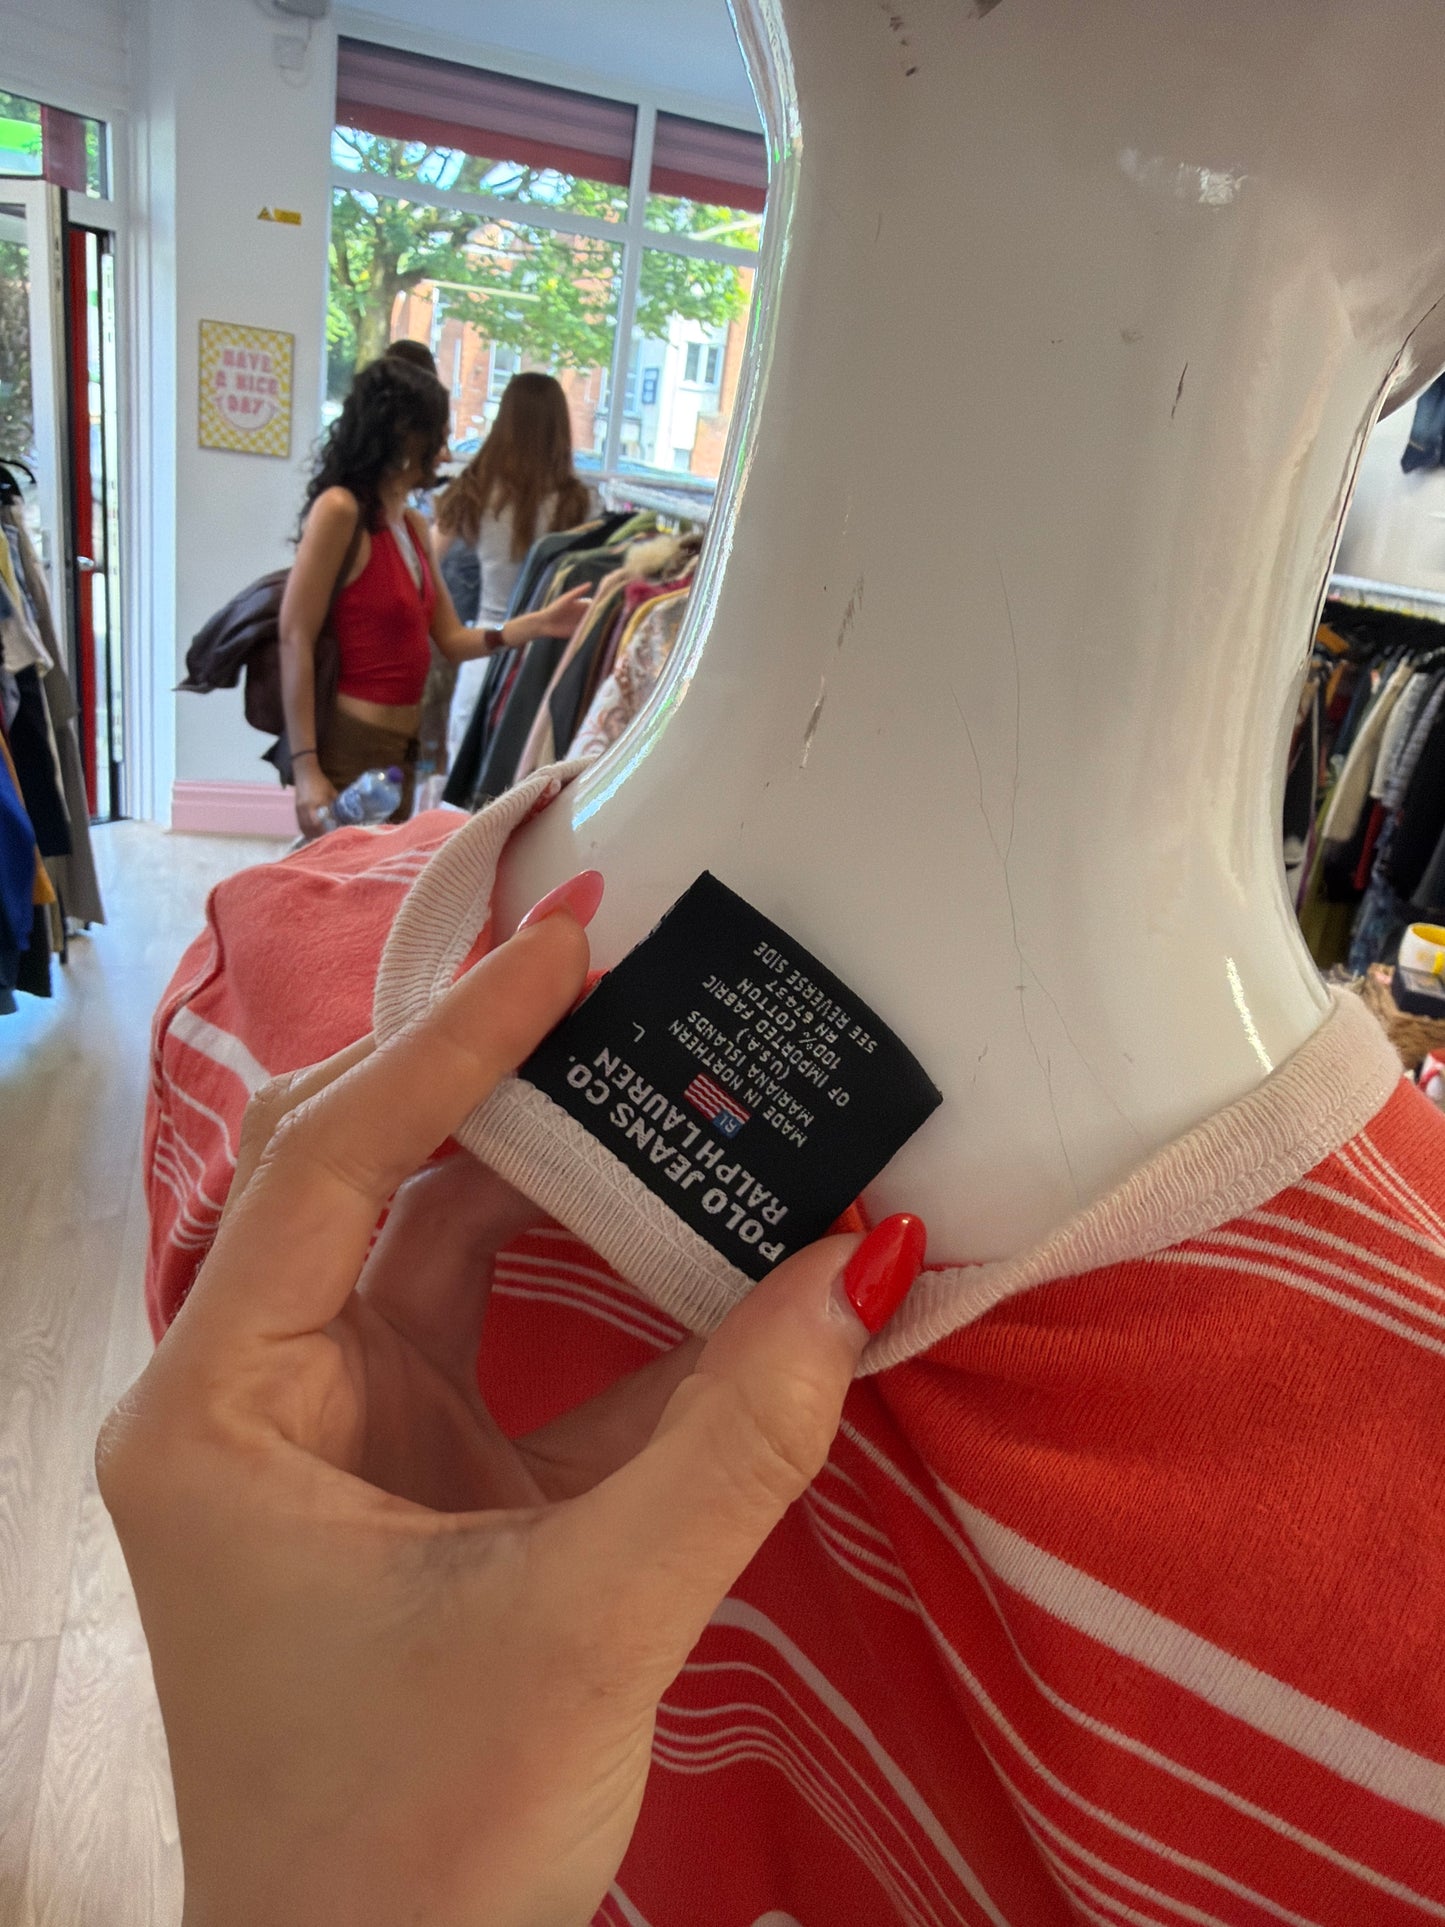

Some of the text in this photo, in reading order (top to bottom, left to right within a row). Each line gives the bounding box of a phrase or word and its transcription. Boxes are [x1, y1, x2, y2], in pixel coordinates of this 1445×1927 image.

[224, 349, 271, 373] HAVE
[228, 395, 264, 415] DAY
[632, 1021, 646, 1043] L
[702, 975, 850, 1107] OF IMPORTED FABRIC
[736, 978, 841, 1070] 100% COTTON
[753, 941, 878, 1054] SEE REVERSE SIDE
[814, 1022, 839, 1044] RN
[668, 1019, 808, 1148] MADE IN NORTHERN
[687, 1010, 815, 1128] MARIANA ISLANDS
[566, 1055, 785, 1263] POLO JEANS CO.
[593, 1047, 788, 1225] RALPH LAUREN
